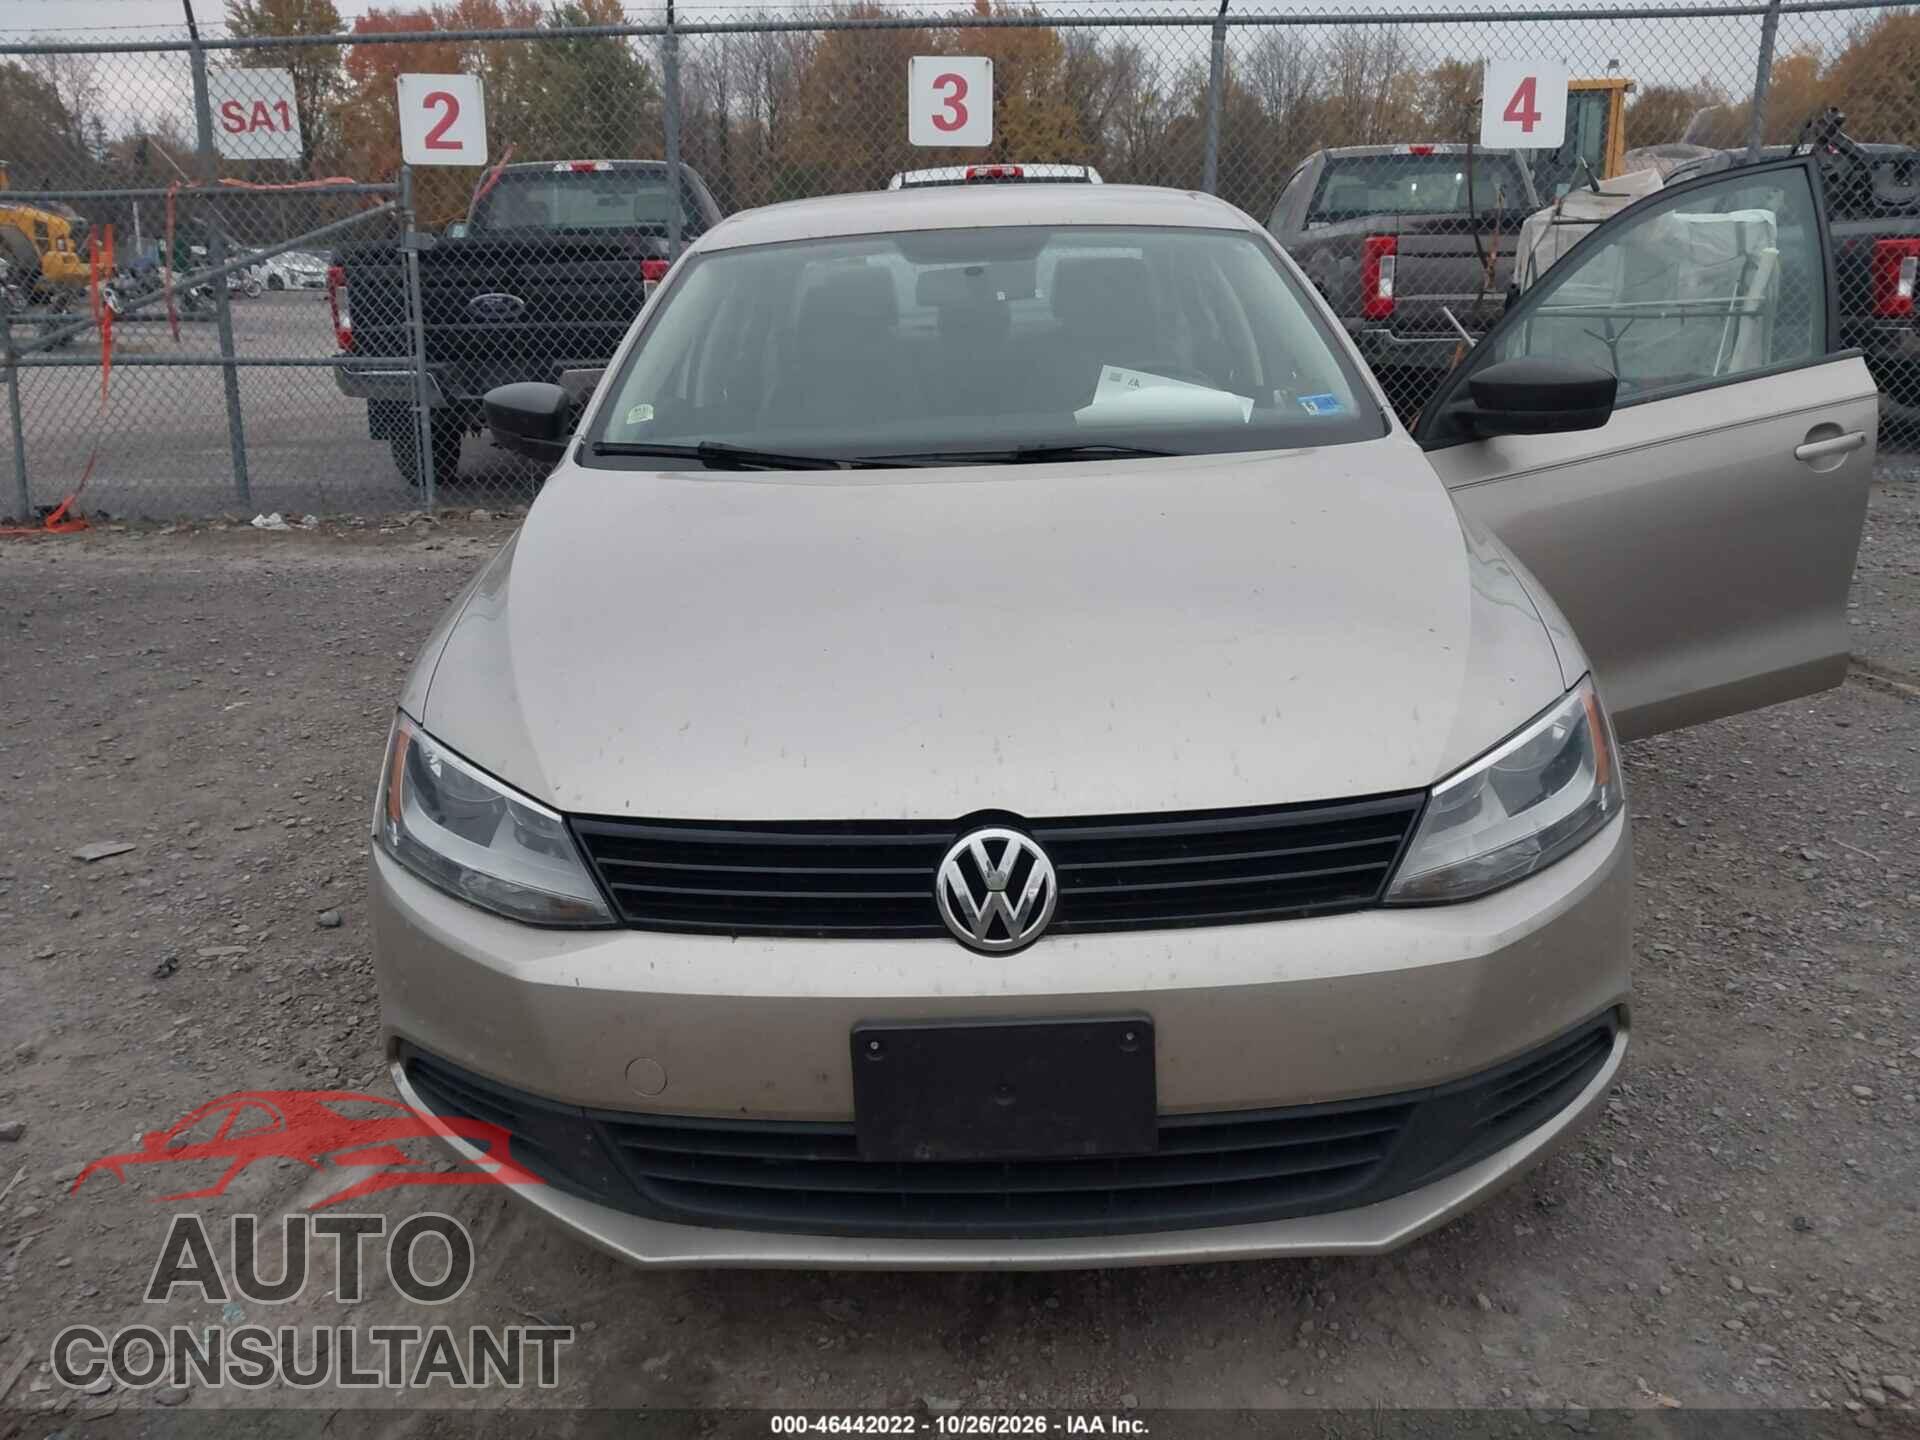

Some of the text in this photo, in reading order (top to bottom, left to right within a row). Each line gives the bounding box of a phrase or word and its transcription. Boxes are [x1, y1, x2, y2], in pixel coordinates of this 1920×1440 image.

[222, 100, 290, 133] SA1
[423, 91, 463, 149] 2
[932, 73, 968, 131] 3
[1503, 77, 1541, 132] 4
[937, 829, 1056, 950] VW
